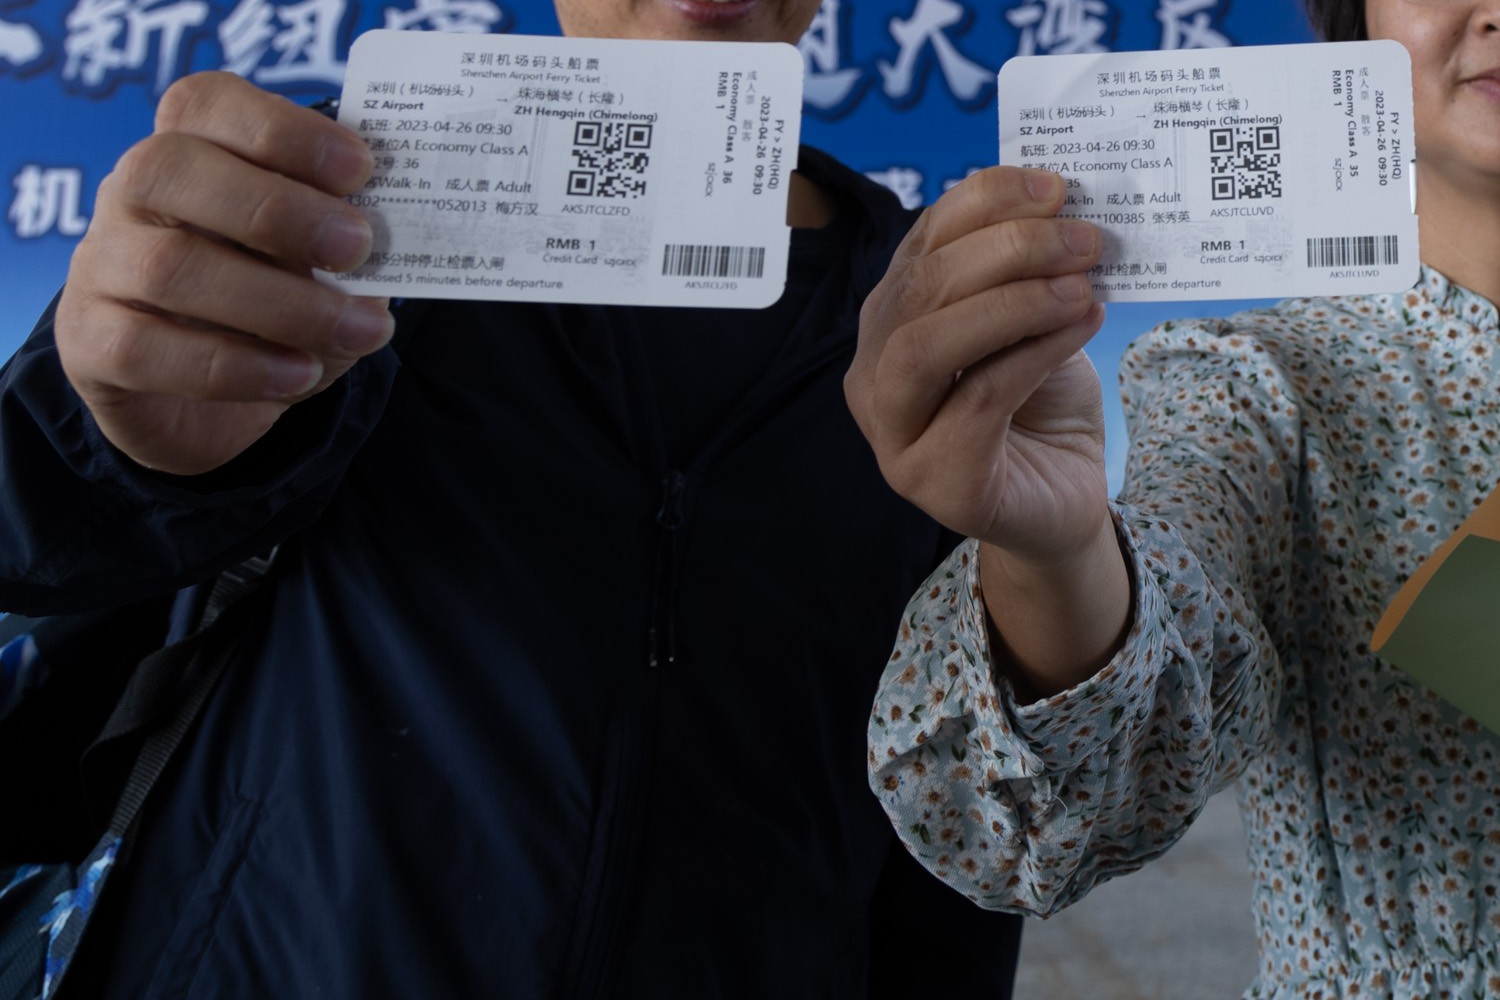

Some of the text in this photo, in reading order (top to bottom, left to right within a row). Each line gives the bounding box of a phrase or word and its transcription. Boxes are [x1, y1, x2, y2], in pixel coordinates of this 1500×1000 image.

[460, 52, 600, 70] 深圳机场码头船票
[460, 69, 601, 84] Shenzhen Airport Ferry Ticket
[717, 72, 728, 97] RMB
[1097, 67, 1221, 86] 深圳机场码头船票
[1332, 70, 1343, 95] RMB
[1099, 83, 1225, 98] Shenzhen Airport Ferry Ticket
[363, 100, 425, 111] SZ Airport
[514, 105, 659, 123] ZH Hengqin (Chimelong)
[1153, 114, 1283, 130] ZH Hengqin (Chimelong)
[1390, 111, 1400, 126] FY
[395, 119, 472, 134] 2023-04-26
[475, 122, 513, 136] 09:30
[722, 72, 742, 184] Economy Class A 36
[774, 119, 785, 133] FY
[1020, 125, 1074, 137] SZ Airport
[1345, 69, 1359, 177] Economy Class A 35
[752, 96, 771, 195] 2023-04-26 09:30
[1375, 90, 1388, 186] 2023-04-26 09:30
[414, 139, 477, 156] Economy
[480, 141, 514, 155] Class
[517, 144, 529, 156] A
[1053, 141, 1121, 155] 2023-04-26
[1123, 138, 1156, 152] 09:30
[403, 157, 419, 170] 36
[1073, 160, 1128, 173] Economy
[1130, 157, 1161, 169] Class
[1163, 156, 1174, 168] A
[1390, 139, 1402, 180] ZH(HQ)
[767, 147, 783, 190] ZH(HQ)
[445, 178, 490, 193] 成人票
[494, 181, 532, 193] Adult
[1066, 178, 1081, 189] 35
[9, 165, 92, 238] 机
[1106, 193, 1145, 207] 成人票
[1149, 191, 1182, 204] Adult
[1210, 206, 1275, 218] AKSJTCLUVD
[546, 237, 596, 251] RMB 1
[1201, 240, 1246, 252] RMB 1
[542, 254, 572, 264] Credit
[574, 255, 598, 265] Card
[1200, 254, 1226, 265] Credit
[1228, 253, 1249, 264] Card
[366, 272, 402, 284] closed
[405, 273, 414, 284] 5
[416, 274, 461, 286] minutes
[465, 275, 503, 288] before
[506, 277, 563, 290] departure
[1091, 278, 1222, 292] minutes before departure
